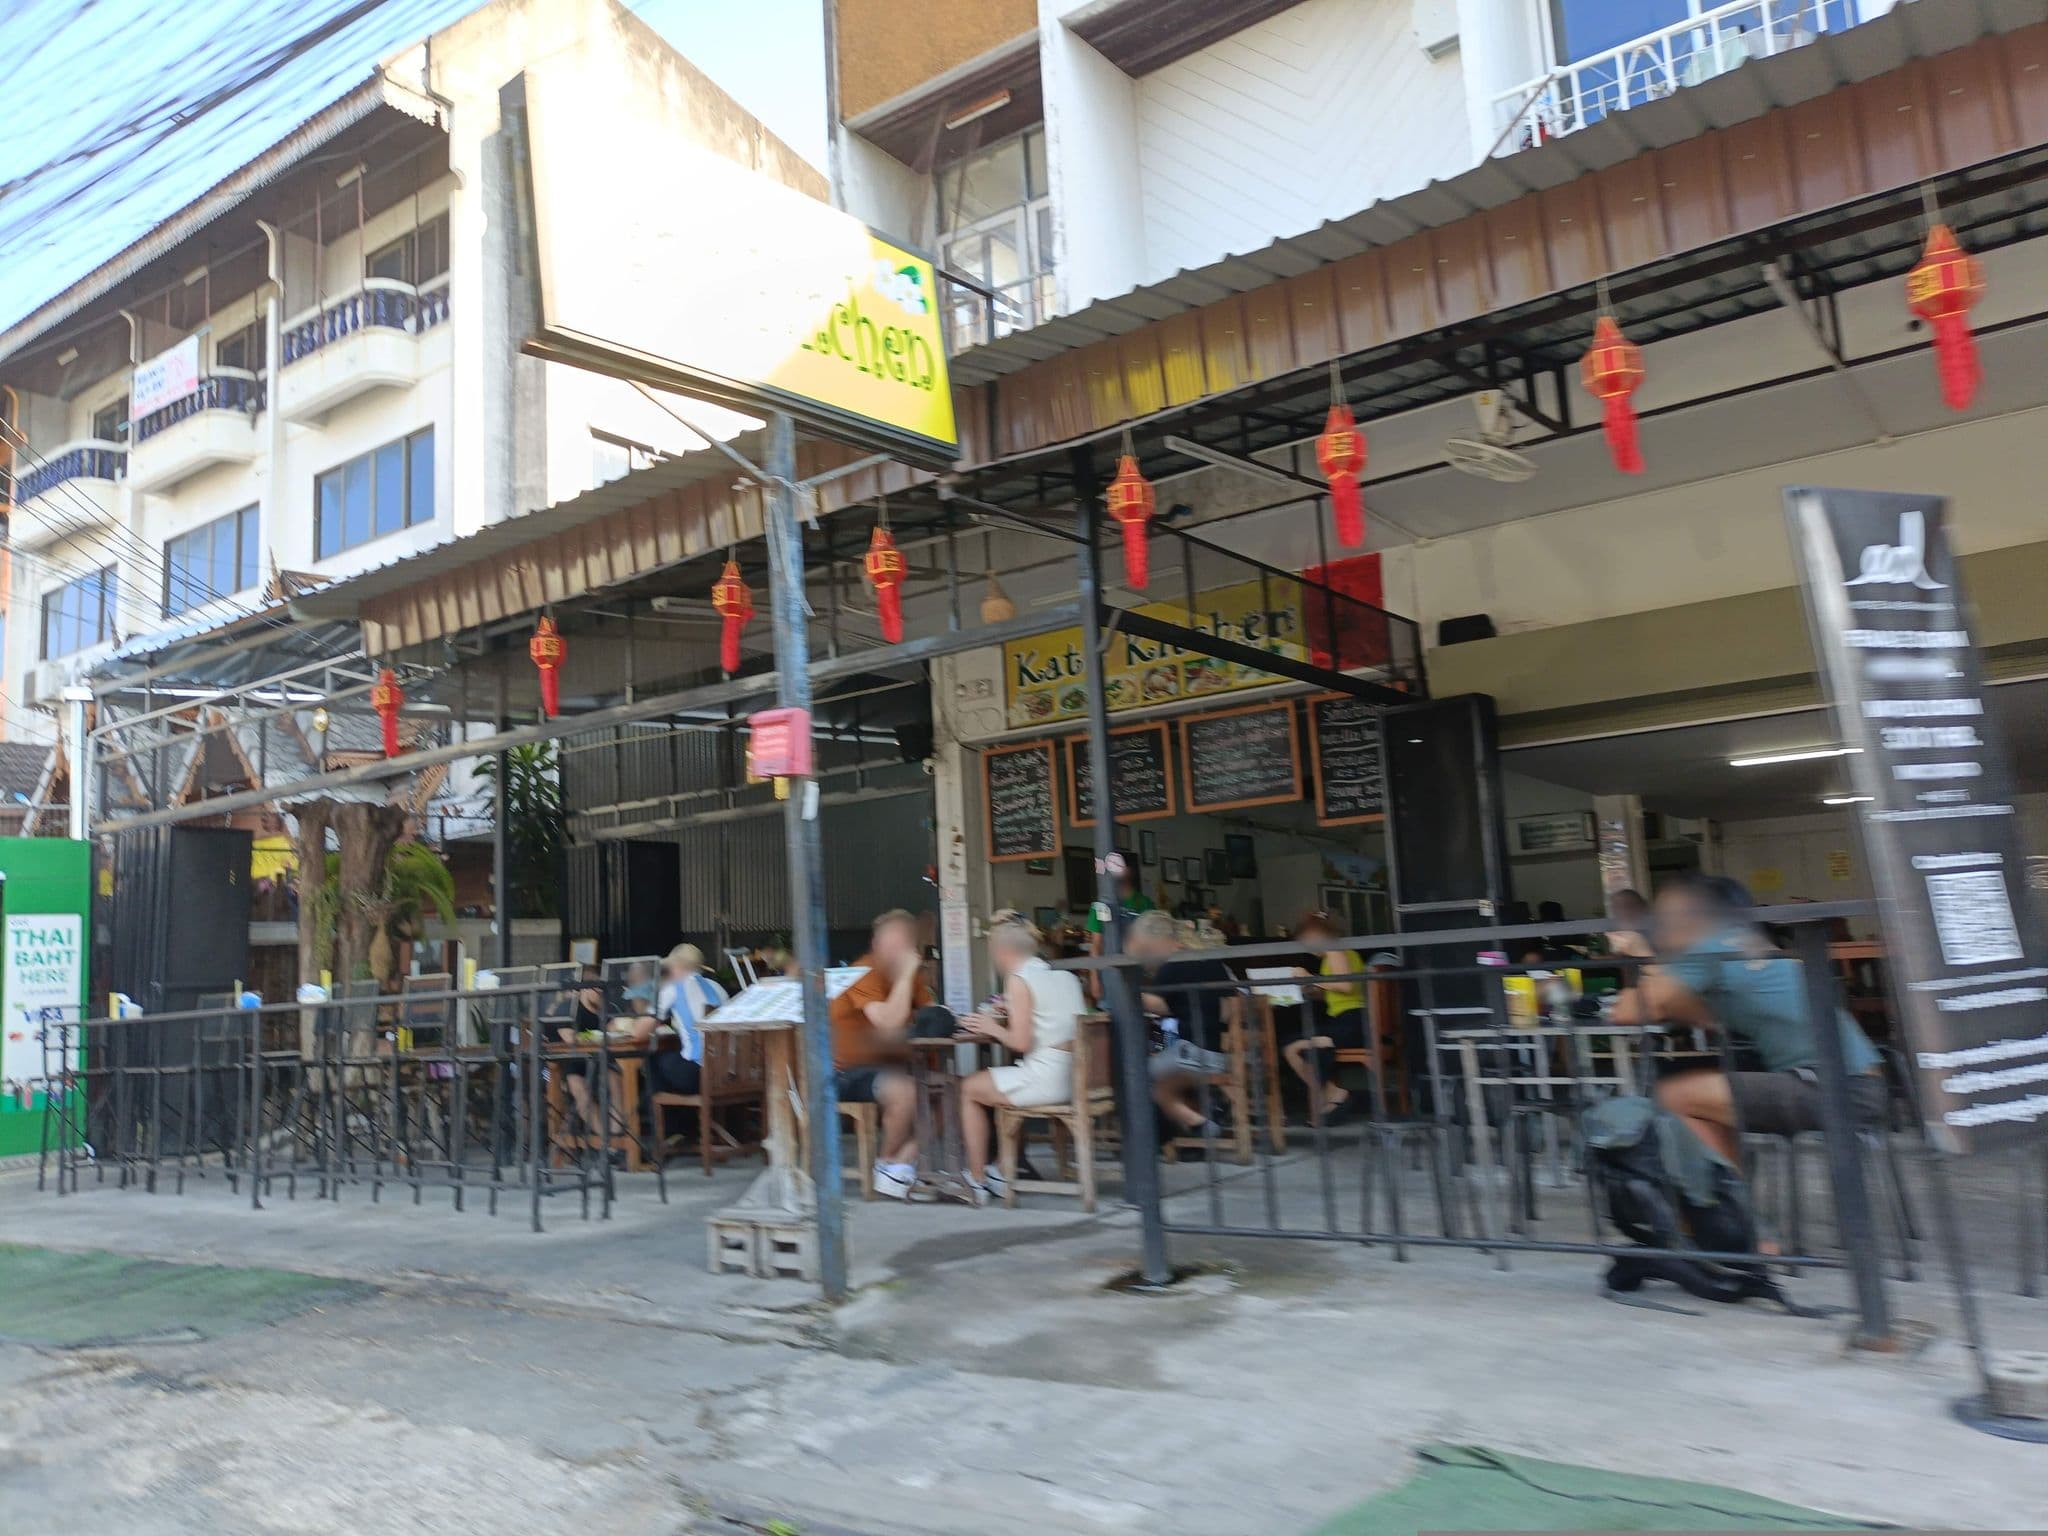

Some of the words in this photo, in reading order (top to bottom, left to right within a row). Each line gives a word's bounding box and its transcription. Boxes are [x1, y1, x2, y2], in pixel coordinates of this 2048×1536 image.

[11, 927, 73, 947] THAI
[15, 948, 77, 967] BAHT
[20, 968, 69, 985] HERE
